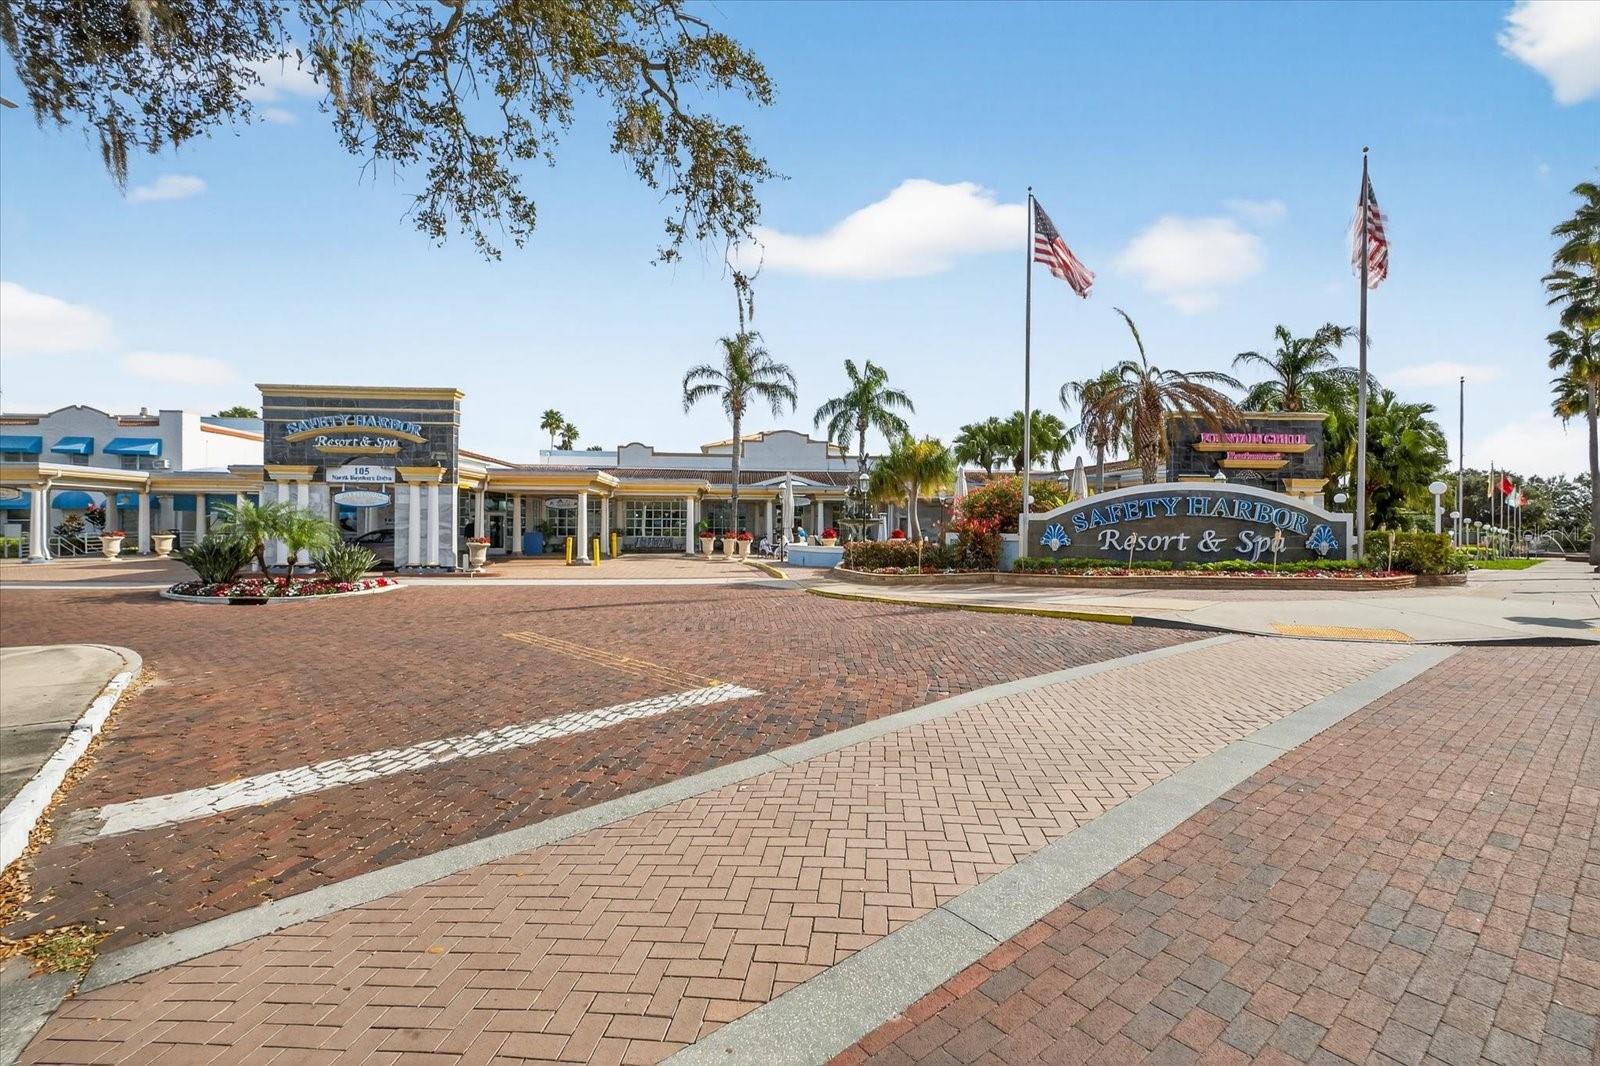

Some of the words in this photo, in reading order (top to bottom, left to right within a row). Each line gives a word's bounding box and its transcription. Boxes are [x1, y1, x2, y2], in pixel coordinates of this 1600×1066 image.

[286, 414, 352, 434] SAFETY
[354, 414, 422, 437] HARBOR
[313, 435, 358, 448] Resort
[360, 436, 372, 447] &
[374, 437, 399, 453] Spa
[354, 467, 370, 475] 105
[1071, 496, 1182, 533] SAFETY
[1187, 496, 1309, 535] HARBOR
[1098, 529, 1190, 551] Resort
[1198, 529, 1227, 552] &
[1235, 530, 1287, 563] Spa
